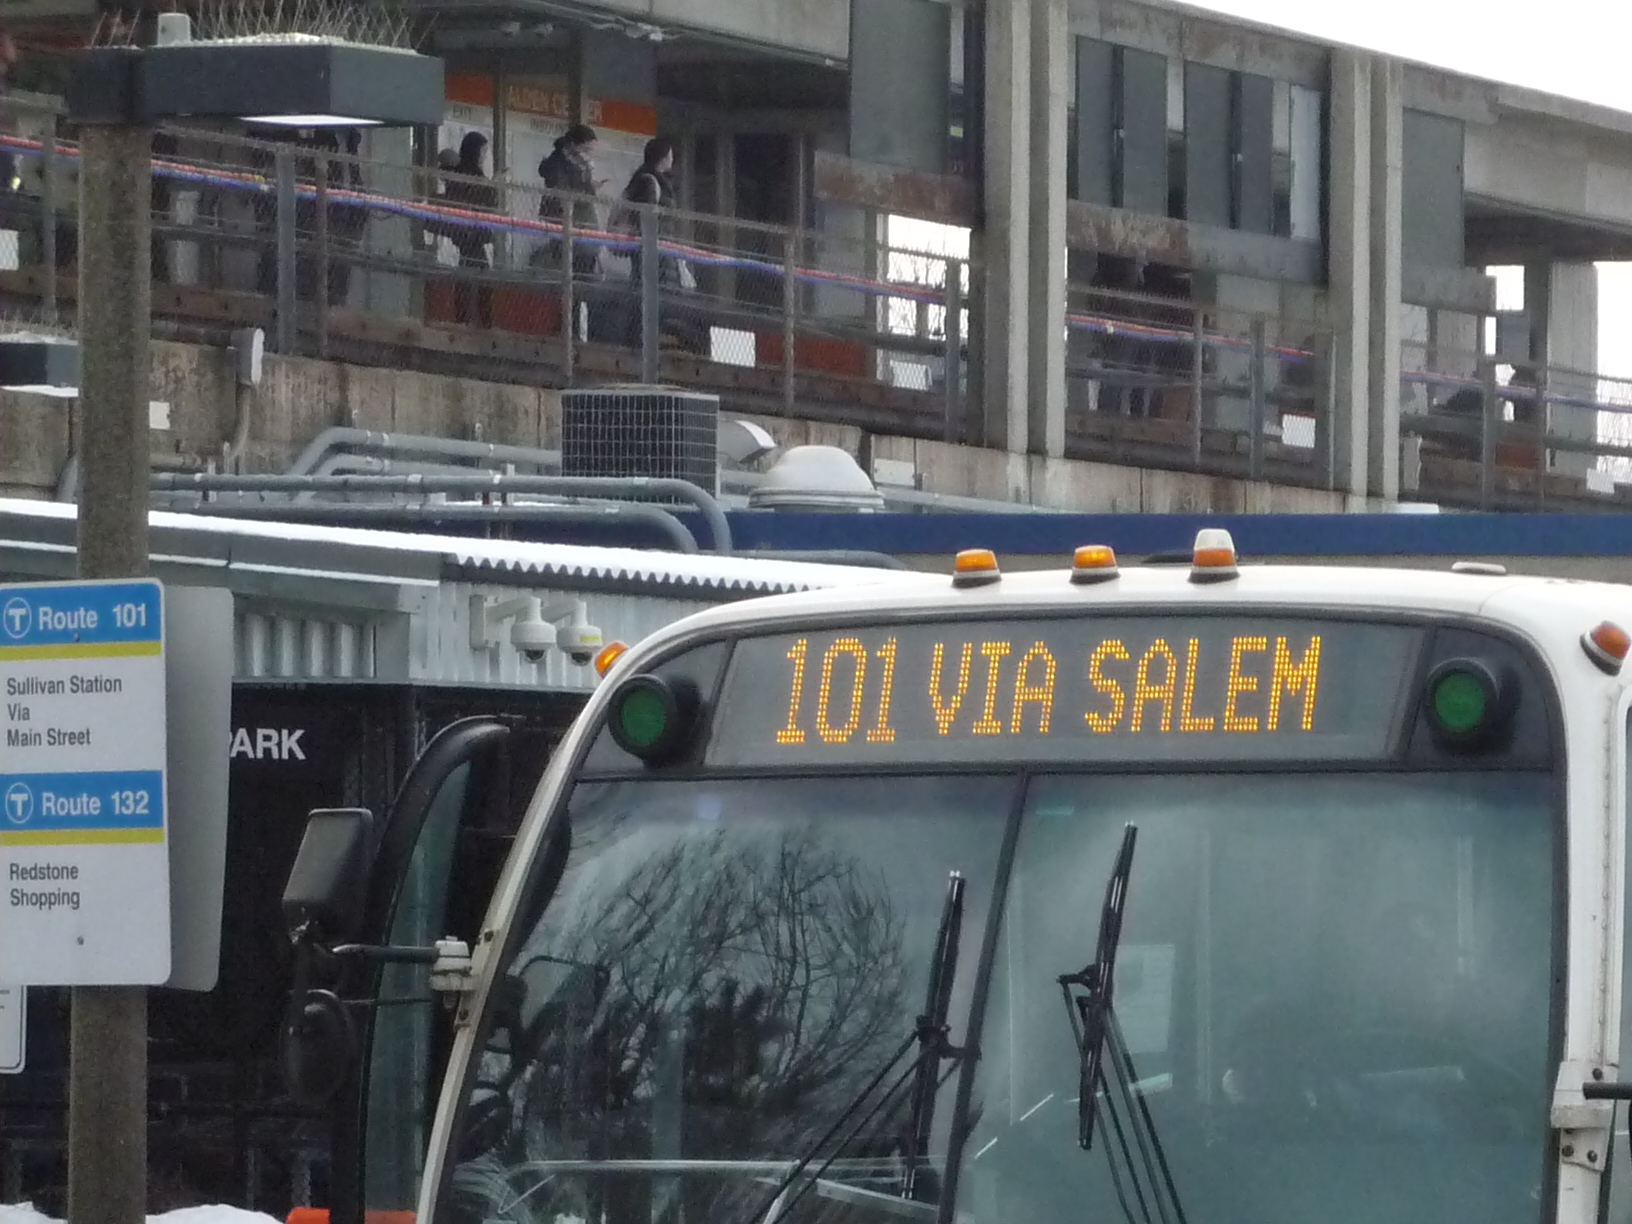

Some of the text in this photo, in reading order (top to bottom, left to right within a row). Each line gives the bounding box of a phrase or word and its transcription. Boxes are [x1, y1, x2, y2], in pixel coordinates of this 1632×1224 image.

[39, 606, 98, 630] Route
[113, 603, 147, 627] 101
[7, 674, 122, 696] Sullivan Station
[776, 635, 1321, 743] 101 VIA SALEM
[7, 704, 30, 721] Via
[7, 727, 91, 747] Main Street
[229, 727, 307, 760] ARK
[42, 792, 101, 816] Route
[111, 790, 149, 815] 132
[9, 862, 79, 881] Redstone
[10, 887, 80, 910] Shopping
